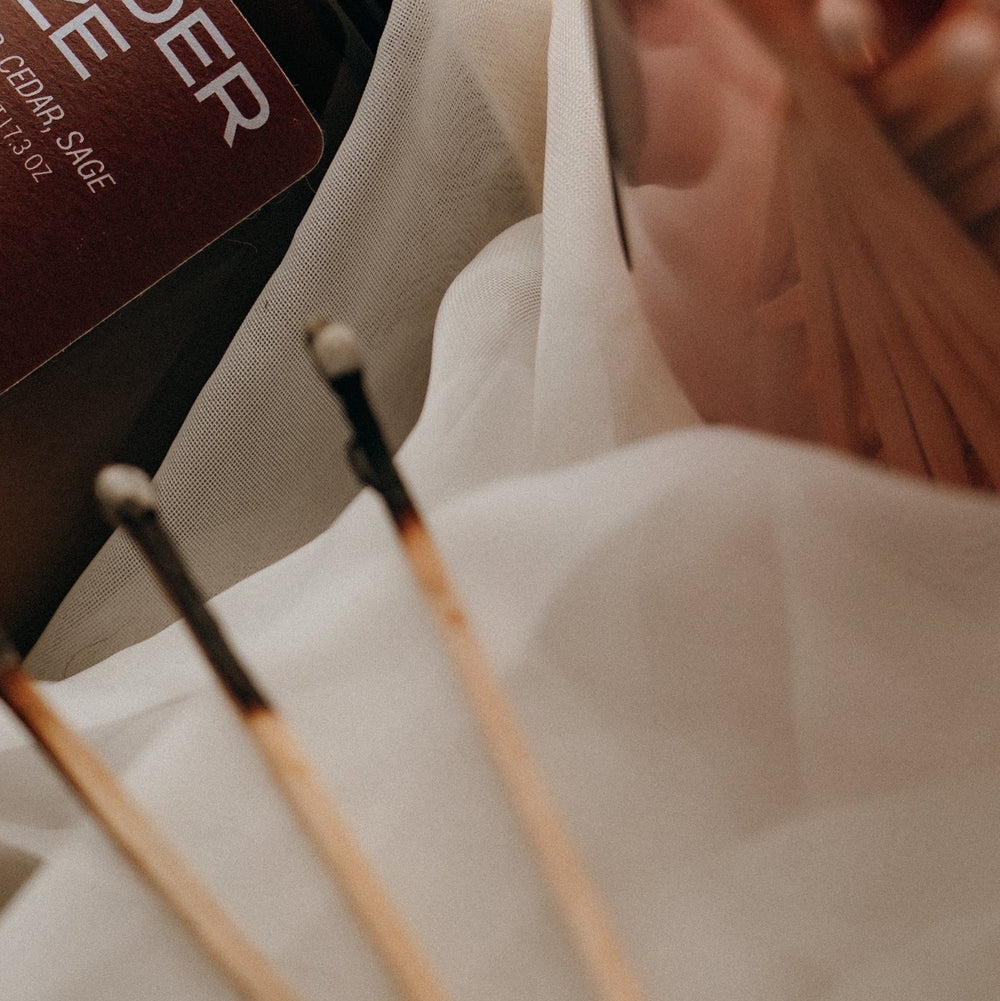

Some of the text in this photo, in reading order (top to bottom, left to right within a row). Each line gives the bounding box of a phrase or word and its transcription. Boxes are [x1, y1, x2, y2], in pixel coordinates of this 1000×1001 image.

[3, 124, 32, 156] 7.3
[23, 153, 53, 184] OZ
[55, 130, 117, 194] SAGE
